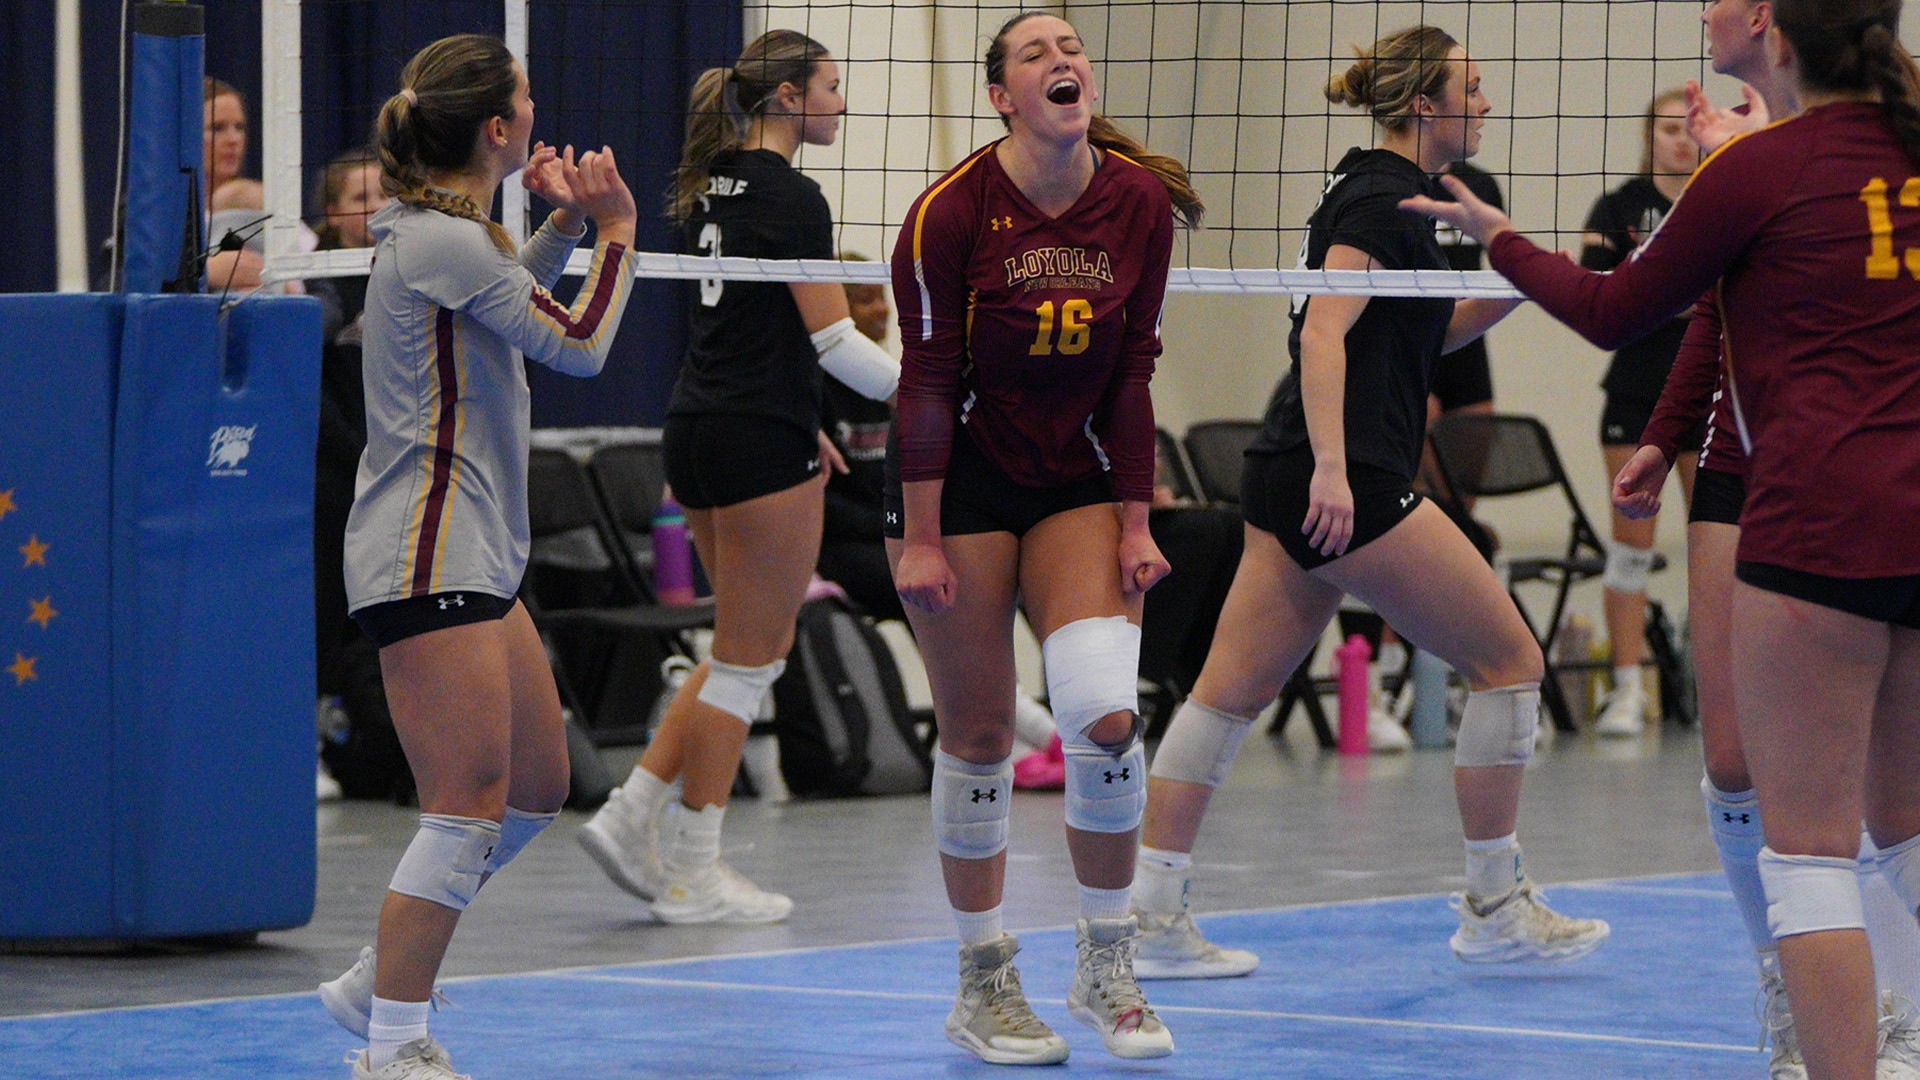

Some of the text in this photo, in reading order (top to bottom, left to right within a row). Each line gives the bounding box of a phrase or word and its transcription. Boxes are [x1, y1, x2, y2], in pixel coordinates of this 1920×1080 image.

[1004, 247, 1114, 287] LOYOLA
[1024, 276, 1101, 292] NEW ORLEANS
[1028, 298, 1094, 356] 16
